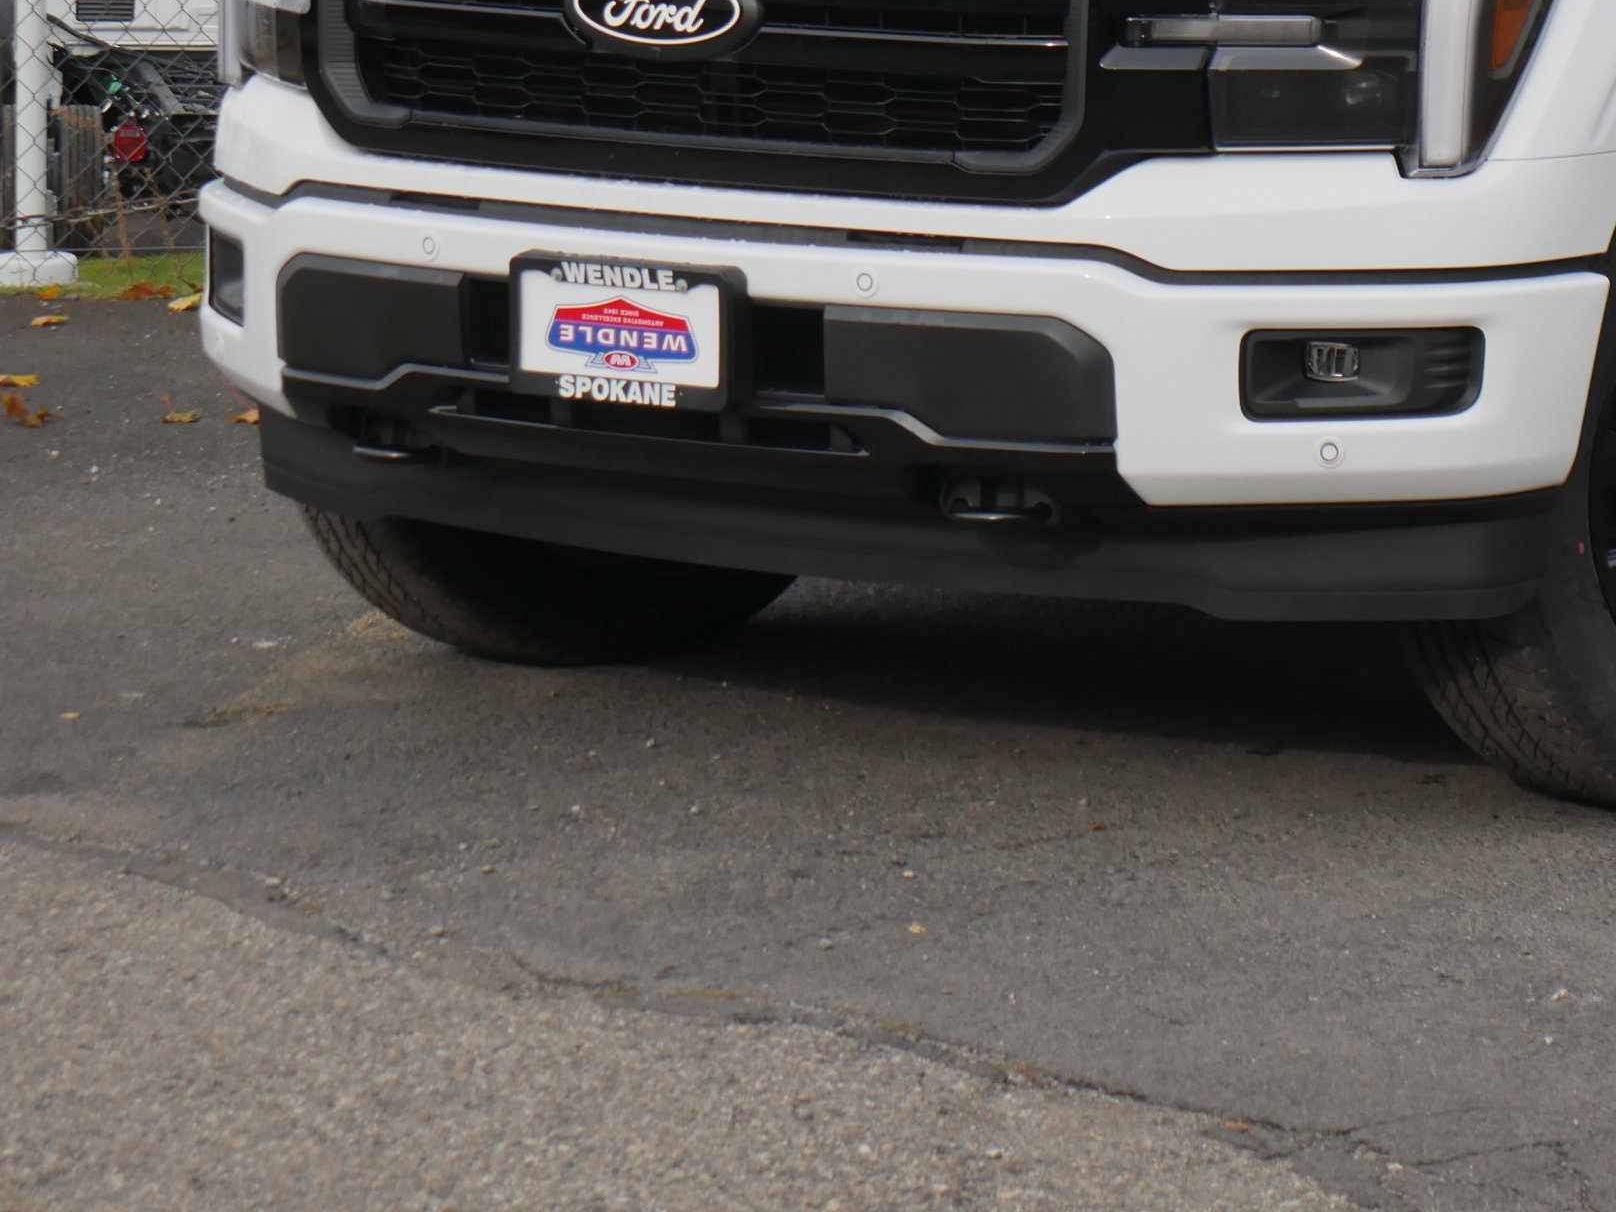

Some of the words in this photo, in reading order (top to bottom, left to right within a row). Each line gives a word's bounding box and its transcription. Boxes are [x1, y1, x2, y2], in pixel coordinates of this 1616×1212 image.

[561, 261, 676, 291] WENDLE
[581, 313, 621, 323] EXCELLENCE
[623, 317, 664, 327] AUTOMOTIVE
[559, 324, 689, 353] WENDLE
[558, 374, 676, 407] SPOKANE
